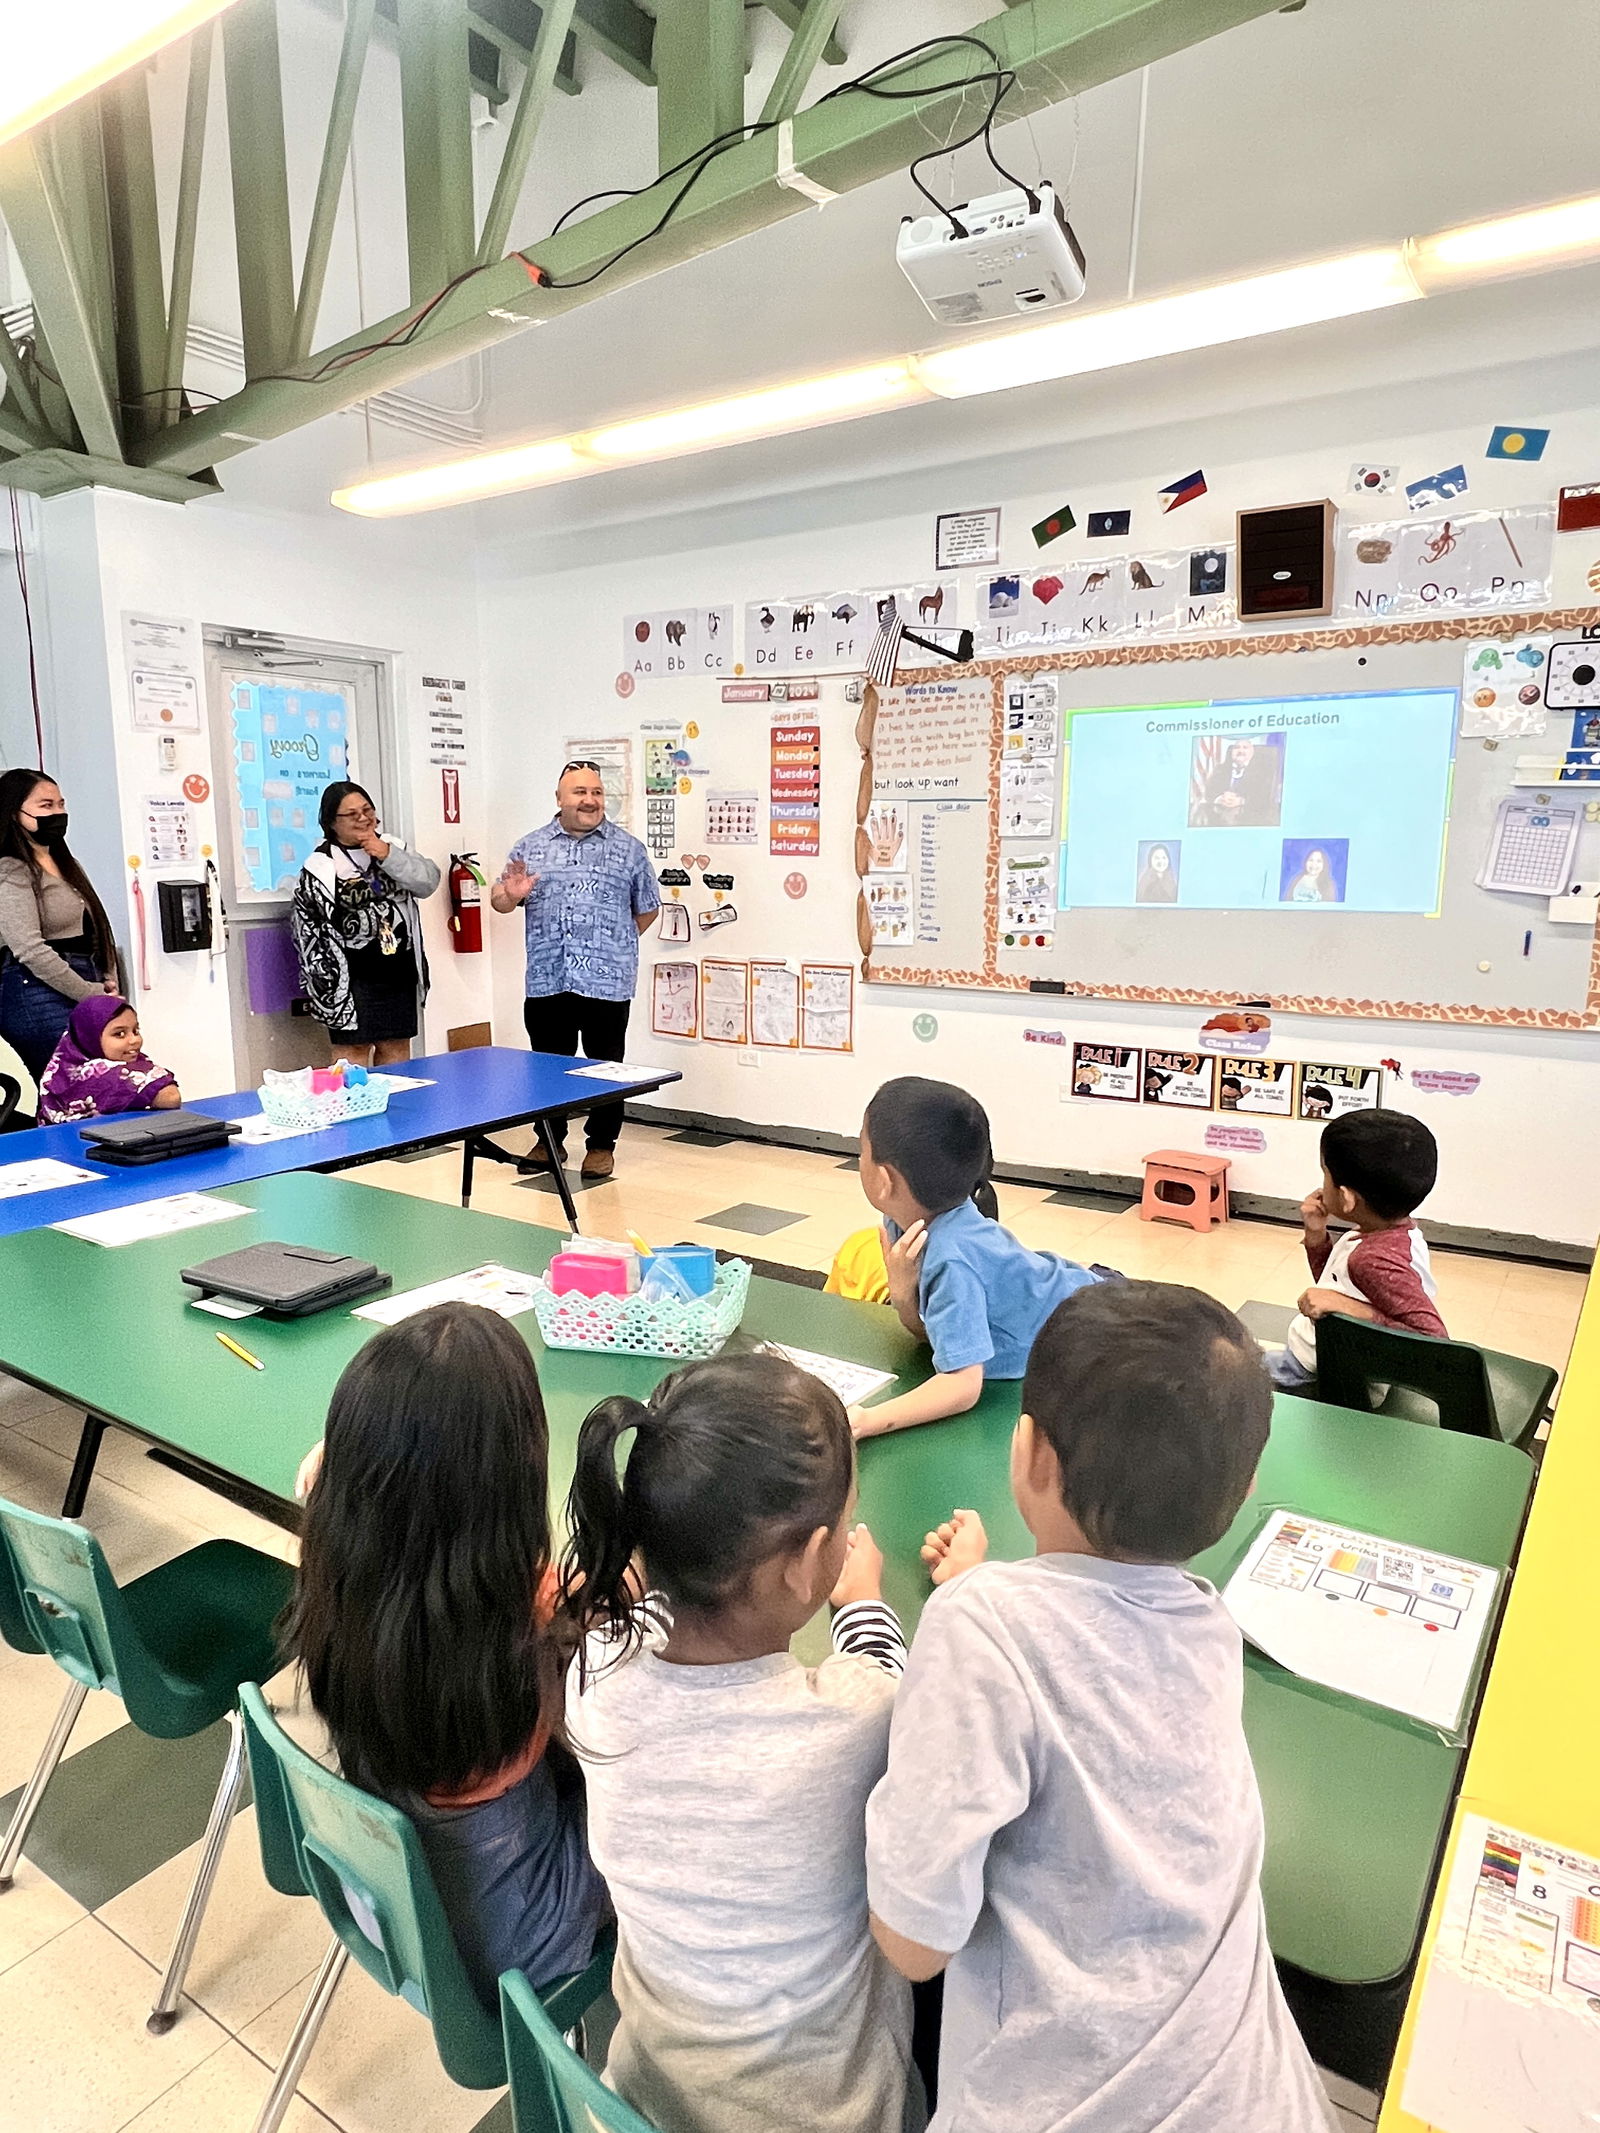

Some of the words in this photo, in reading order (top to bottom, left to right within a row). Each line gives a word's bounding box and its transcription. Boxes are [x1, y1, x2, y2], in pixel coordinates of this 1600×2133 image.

[756, 647, 776, 663] Dd
[795, 646, 813, 660] Ee
[836, 640, 853, 656] Ff
[634, 659, 652, 672] Aa
[667, 656, 685, 670] Bb
[704, 653, 722, 667] Cc
[723, 687, 764, 699] January
[789, 685, 815, 697] 2024
[905, 686, 927, 695] Words
[929, 686, 936, 694] to
[937, 684, 958, 694] Know
[1146, 718, 1244, 733] Commissioner
[1248, 716, 1263, 728] of
[1266, 712, 1340, 727] Education
[776, 731, 814, 743] Sunday
[776, 751, 815, 763] Monday
[774, 768, 815, 780] Tuesday
[874, 780, 890, 789] but
[895, 779, 914, 789] look
[918, 779, 931, 790] up
[934, 778, 958, 787] want
[772, 788, 818, 799] Wednesday
[771, 805, 819, 818] Thursday
[777, 823, 811, 836] Friday
[771, 839, 818, 853] Saturday
[1025, 1033, 1036, 1042] Be
[1041, 1035, 1061, 1045] Kind
[1205, 1039, 1231, 1049] Class
[1081, 1046, 1113, 1063] RULE
[1148, 1052, 1181, 1071] RULE
[1183, 1052, 1199, 1076] 2
[1225, 1059, 1261, 1078] RULE
[1262, 1061, 1276, 1082] 3
[1306, 1066, 1344, 1085] RULE
[1346, 1065, 1362, 1090] 4
[1533, 1885, 1547, 1899] 8
